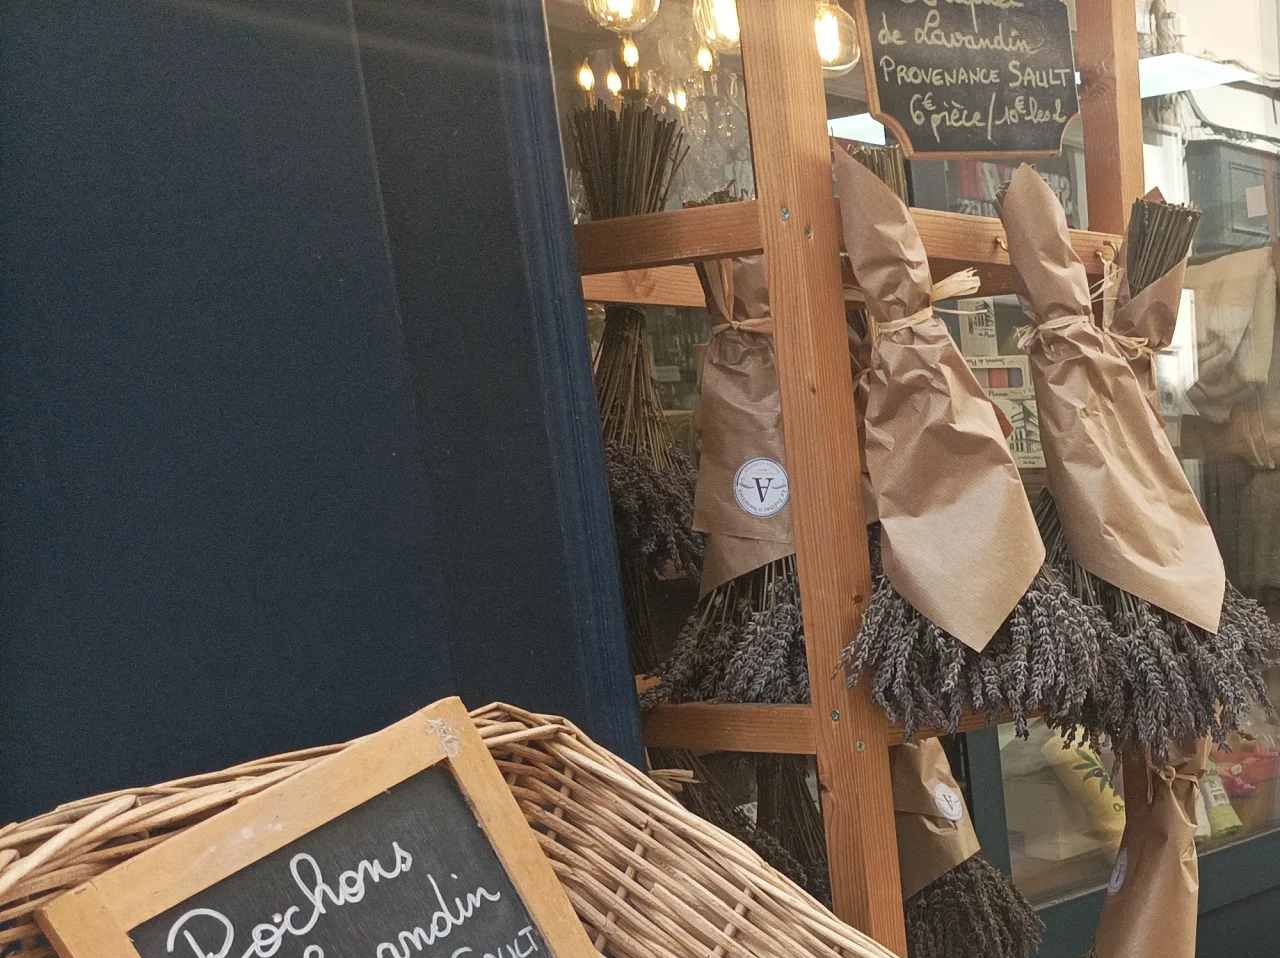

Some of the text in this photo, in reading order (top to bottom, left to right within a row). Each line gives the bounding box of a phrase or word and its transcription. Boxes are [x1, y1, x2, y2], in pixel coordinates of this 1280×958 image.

[878, 12, 907, 46] de
[880, 55, 1071, 88] PROVENANCE SAULT
